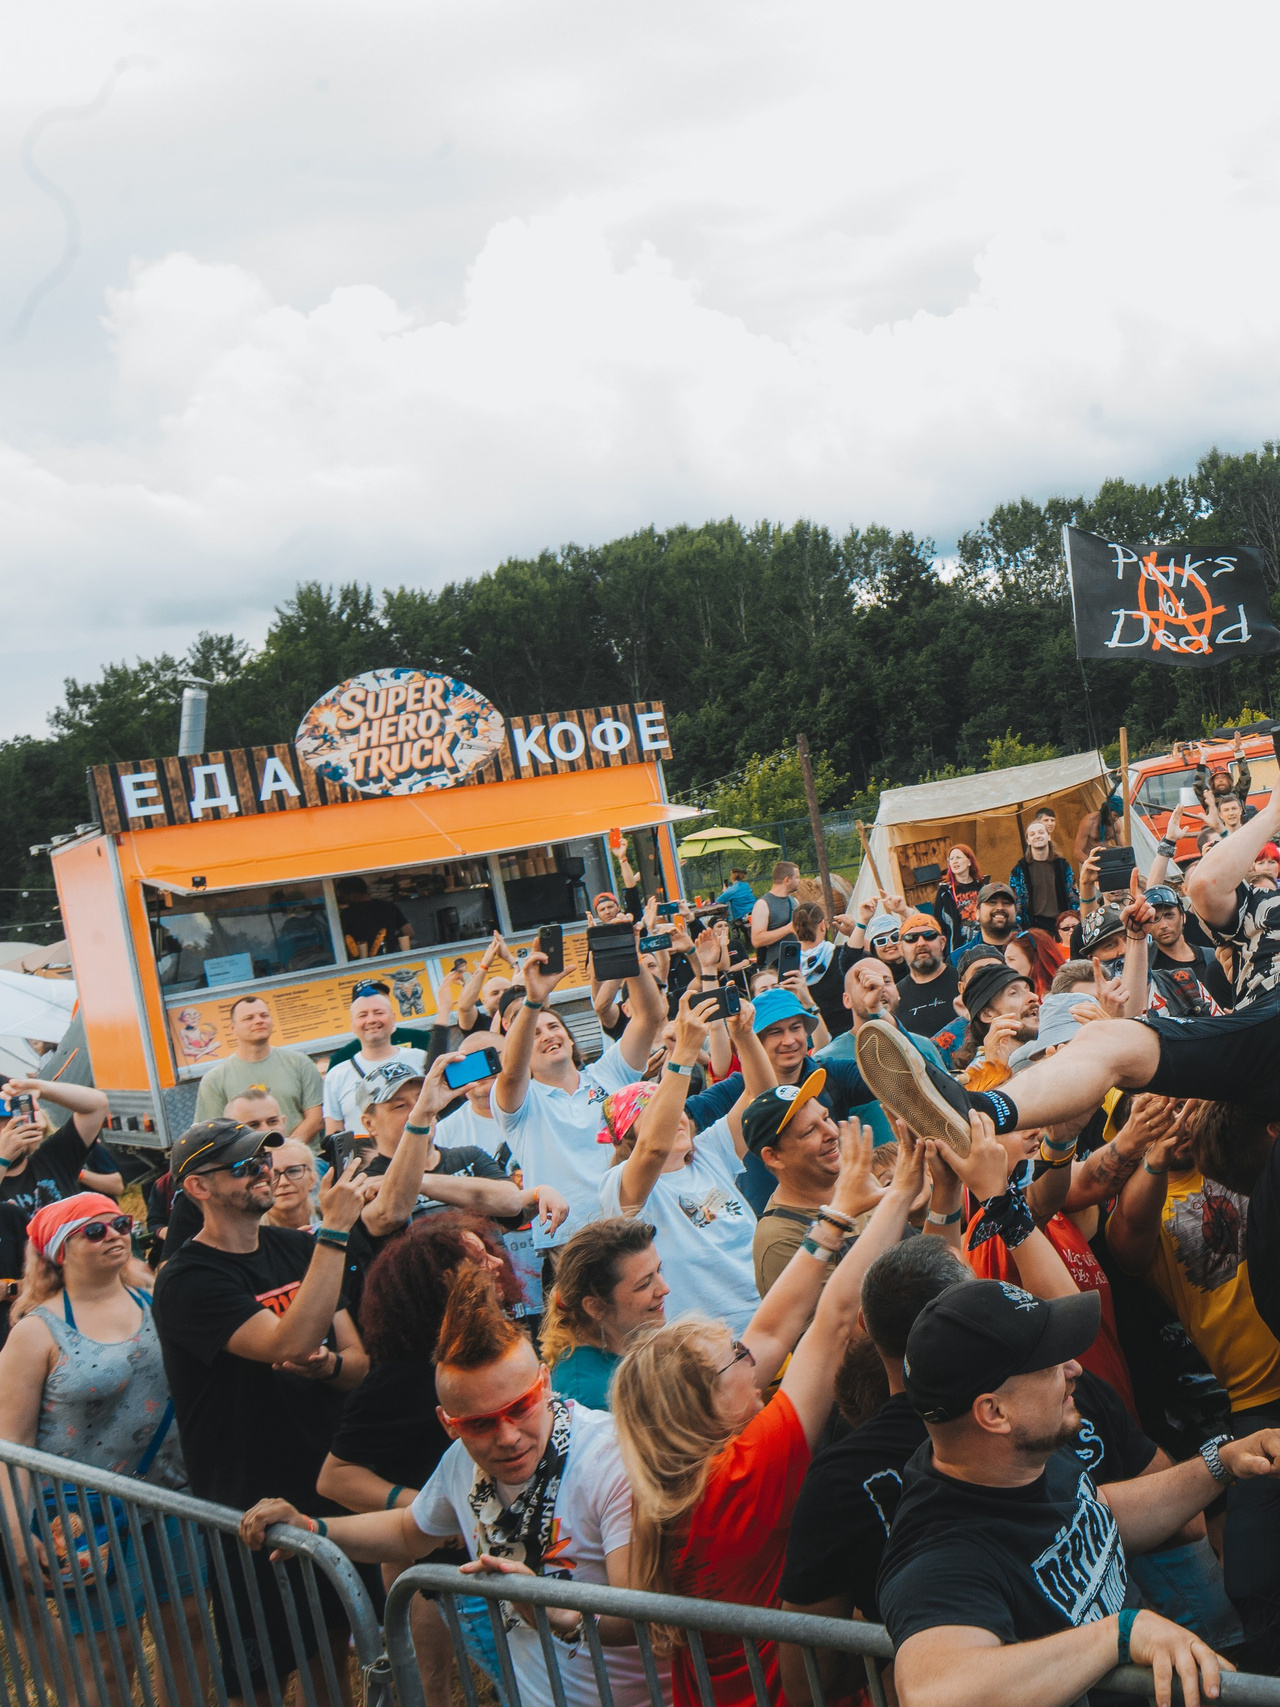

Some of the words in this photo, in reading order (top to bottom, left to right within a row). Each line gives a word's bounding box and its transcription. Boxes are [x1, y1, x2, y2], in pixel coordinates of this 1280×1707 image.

[1103, 603, 1252, 654] Dead
[336, 678, 449, 730] SUPER
[358, 709, 442, 749] HERO
[350, 732, 457, 781] TRUCK
[513, 711, 669, 767] КОФЕ
[119, 756, 302, 819] ЕДА
